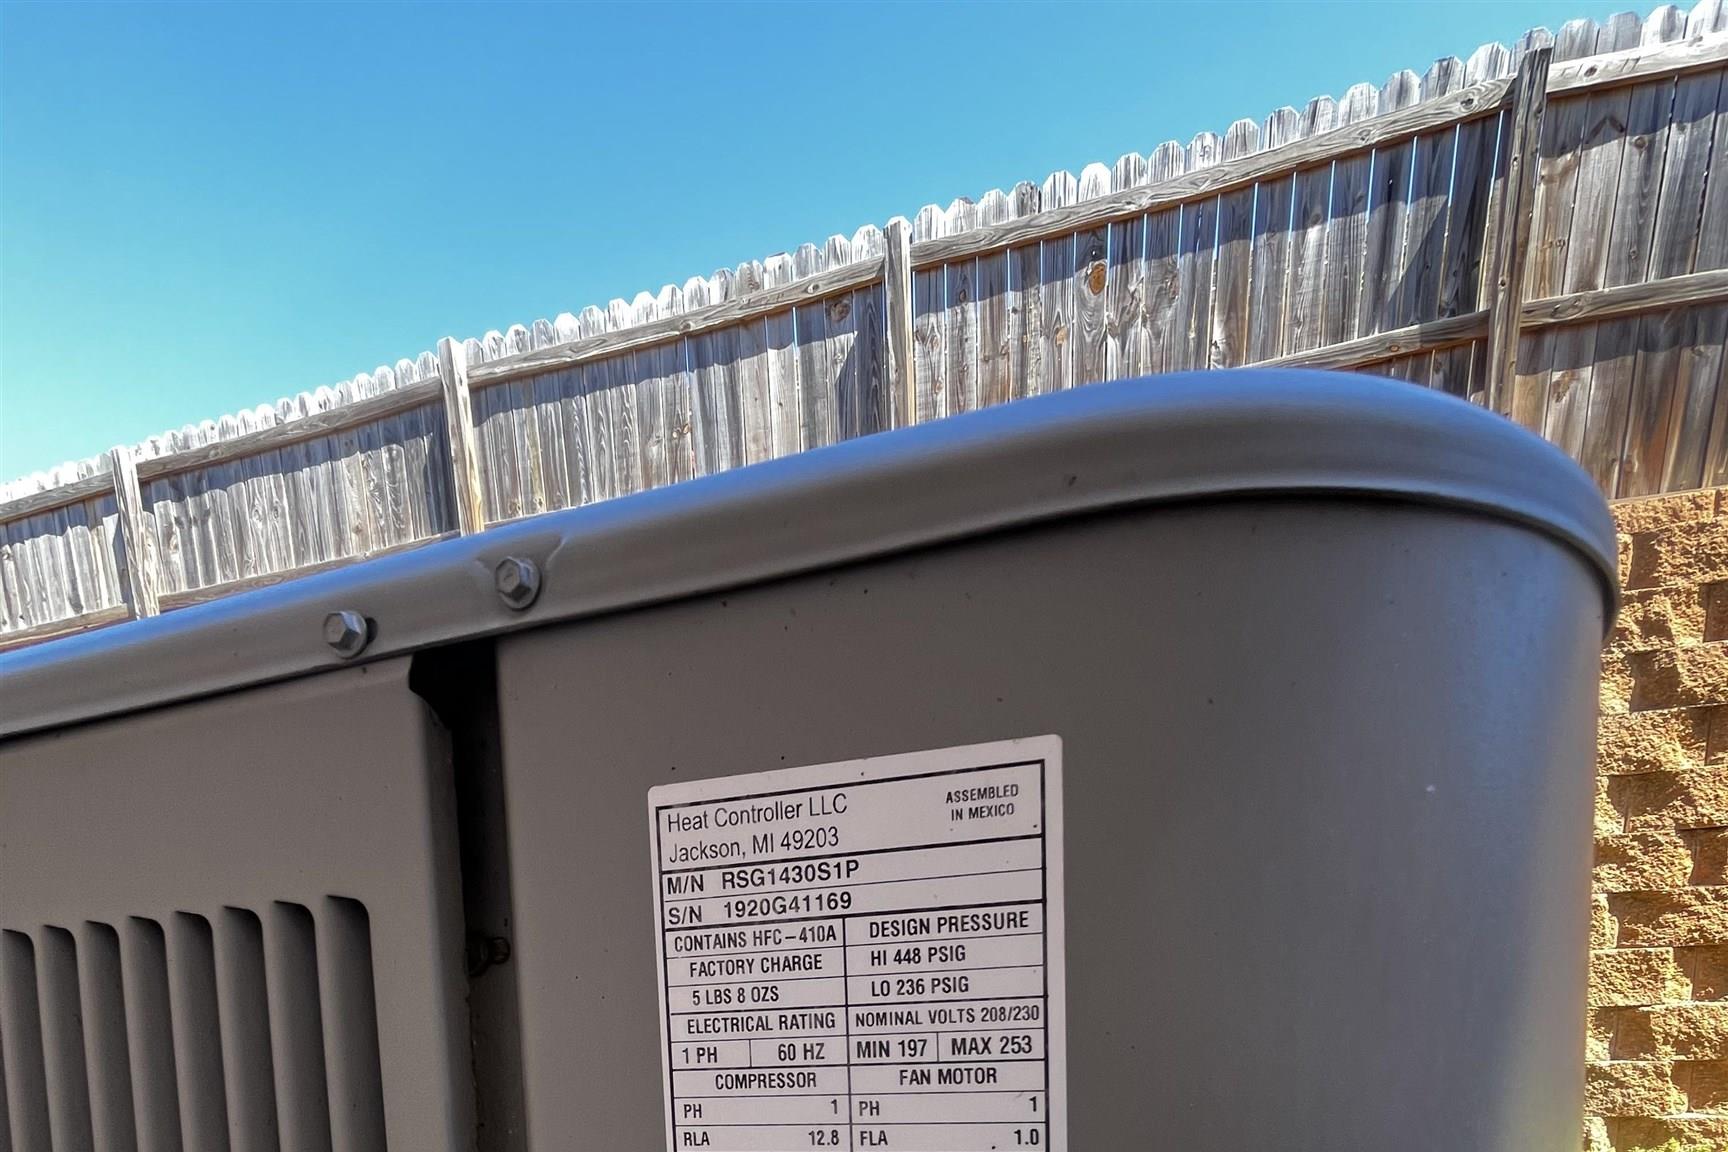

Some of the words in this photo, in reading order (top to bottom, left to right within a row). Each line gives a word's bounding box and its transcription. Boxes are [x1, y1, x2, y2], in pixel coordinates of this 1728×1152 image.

[946, 784, 1019, 804] ASSEMBLED
[667, 814, 709, 832] Heat
[714, 800, 803, 827] Controller
[808, 793, 848, 816] LLC
[951, 808, 965, 821] IN
[968, 803, 1014, 819] MEXICO
[669, 839, 746, 863] Jackson,
[752, 834, 774, 855] MI
[780, 827, 839, 851] 49203
[667, 874, 704, 895] M/N
[721, 860, 859, 890] RSG1430S1P
[668, 905, 702, 925] S/N
[724, 892, 852, 918] 1920G41169
[869, 917, 931, 938] DESIGN
[937, 911, 1029, 934] PRESSURE
[674, 932, 747, 952] CONTAINS
[871, 951, 887, 966] HI
[893, 948, 922, 964] 448
[928, 946, 966, 963] PSIG
[690, 959, 754, 978] FACTORY
[760, 954, 822, 972] CHARGE
[692, 991, 701, 1005] 5
[705, 989, 732, 1005] LBS
[737, 988, 746, 1003] 8
[751, 986, 779, 1003] OZS
[871, 981, 890, 997] LO
[896, 979, 925, 995] 236
[931, 976, 969, 993] PSIG
[687, 1016, 774, 1034] ELECTRICAL
[778, 1013, 836, 1030] RATING
[855, 1011, 923, 1027] NOMINAL
[928, 1008, 975, 1024] VOLTS
[980, 1005, 1039, 1022] 208/230
[682, 1048, 690, 1063] 1
[696, 1047, 718, 1063] PH
[778, 1044, 796, 1061] 60
[803, 1043, 825, 1060] HZ
[856, 1040, 890, 1058] MIN
[897, 1039, 927, 1057] 197
[951, 1037, 992, 1055] MAX
[999, 1036, 1032, 1054] 253
[715, 1072, 817, 1090] COMPRESSOR
[900, 1070, 931, 1086] FAN
[938, 1067, 997, 1085] MOTOR
[684, 1104, 703, 1119] PH
[831, 1100, 838, 1114] 1
[859, 1101, 880, 1116] PH
[1029, 1097, 1037, 1112] 1
[683, 1132, 710, 1146] RLA
[808, 1131, 839, 1146] 12.8
[860, 1131, 888, 1146] FLA
[1014, 1130, 1039, 1145] 1.0
